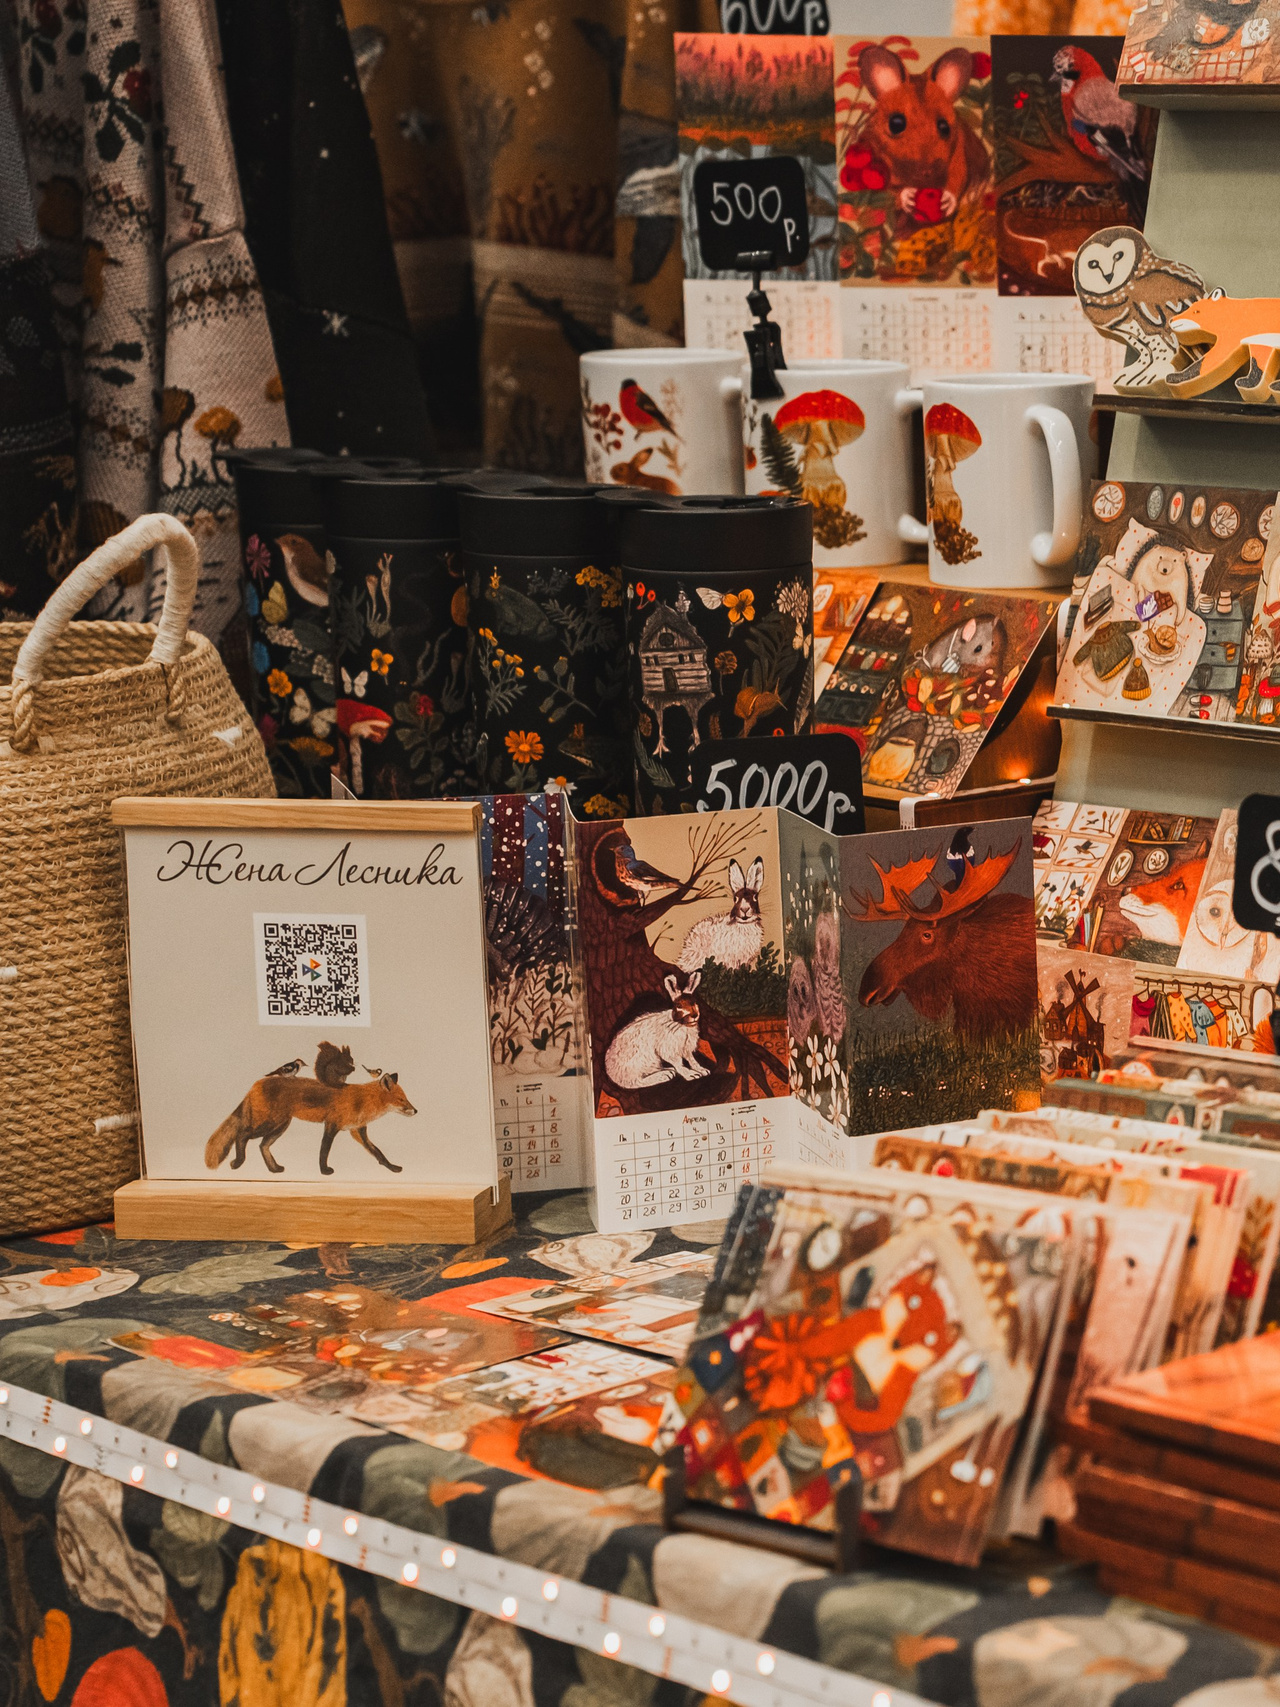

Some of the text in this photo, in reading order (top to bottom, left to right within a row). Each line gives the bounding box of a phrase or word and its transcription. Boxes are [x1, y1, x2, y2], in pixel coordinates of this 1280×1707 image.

[711, 182, 800, 253] 500р.
[156, 840, 463, 886] Жена Лесника
[551, 1107, 556, 1117] 1
[503, 1123, 557, 1136] 6 7 8
[669, 1128, 771, 1152] 1 2 3 4 5
[503, 1139, 559, 1151] 13 14 15
[503, 1154, 560, 1167] 20 21 22
[620, 1144, 772, 1174] 6 7 8 9 10 11 12
[526, 1169, 539, 1179] 28
[620, 1163, 750, 1189] 13 14 15 16 17 18
[621, 1182, 728, 1205] 20 21 22 23 24
[622, 1200, 707, 1220] 27 28 29 30
